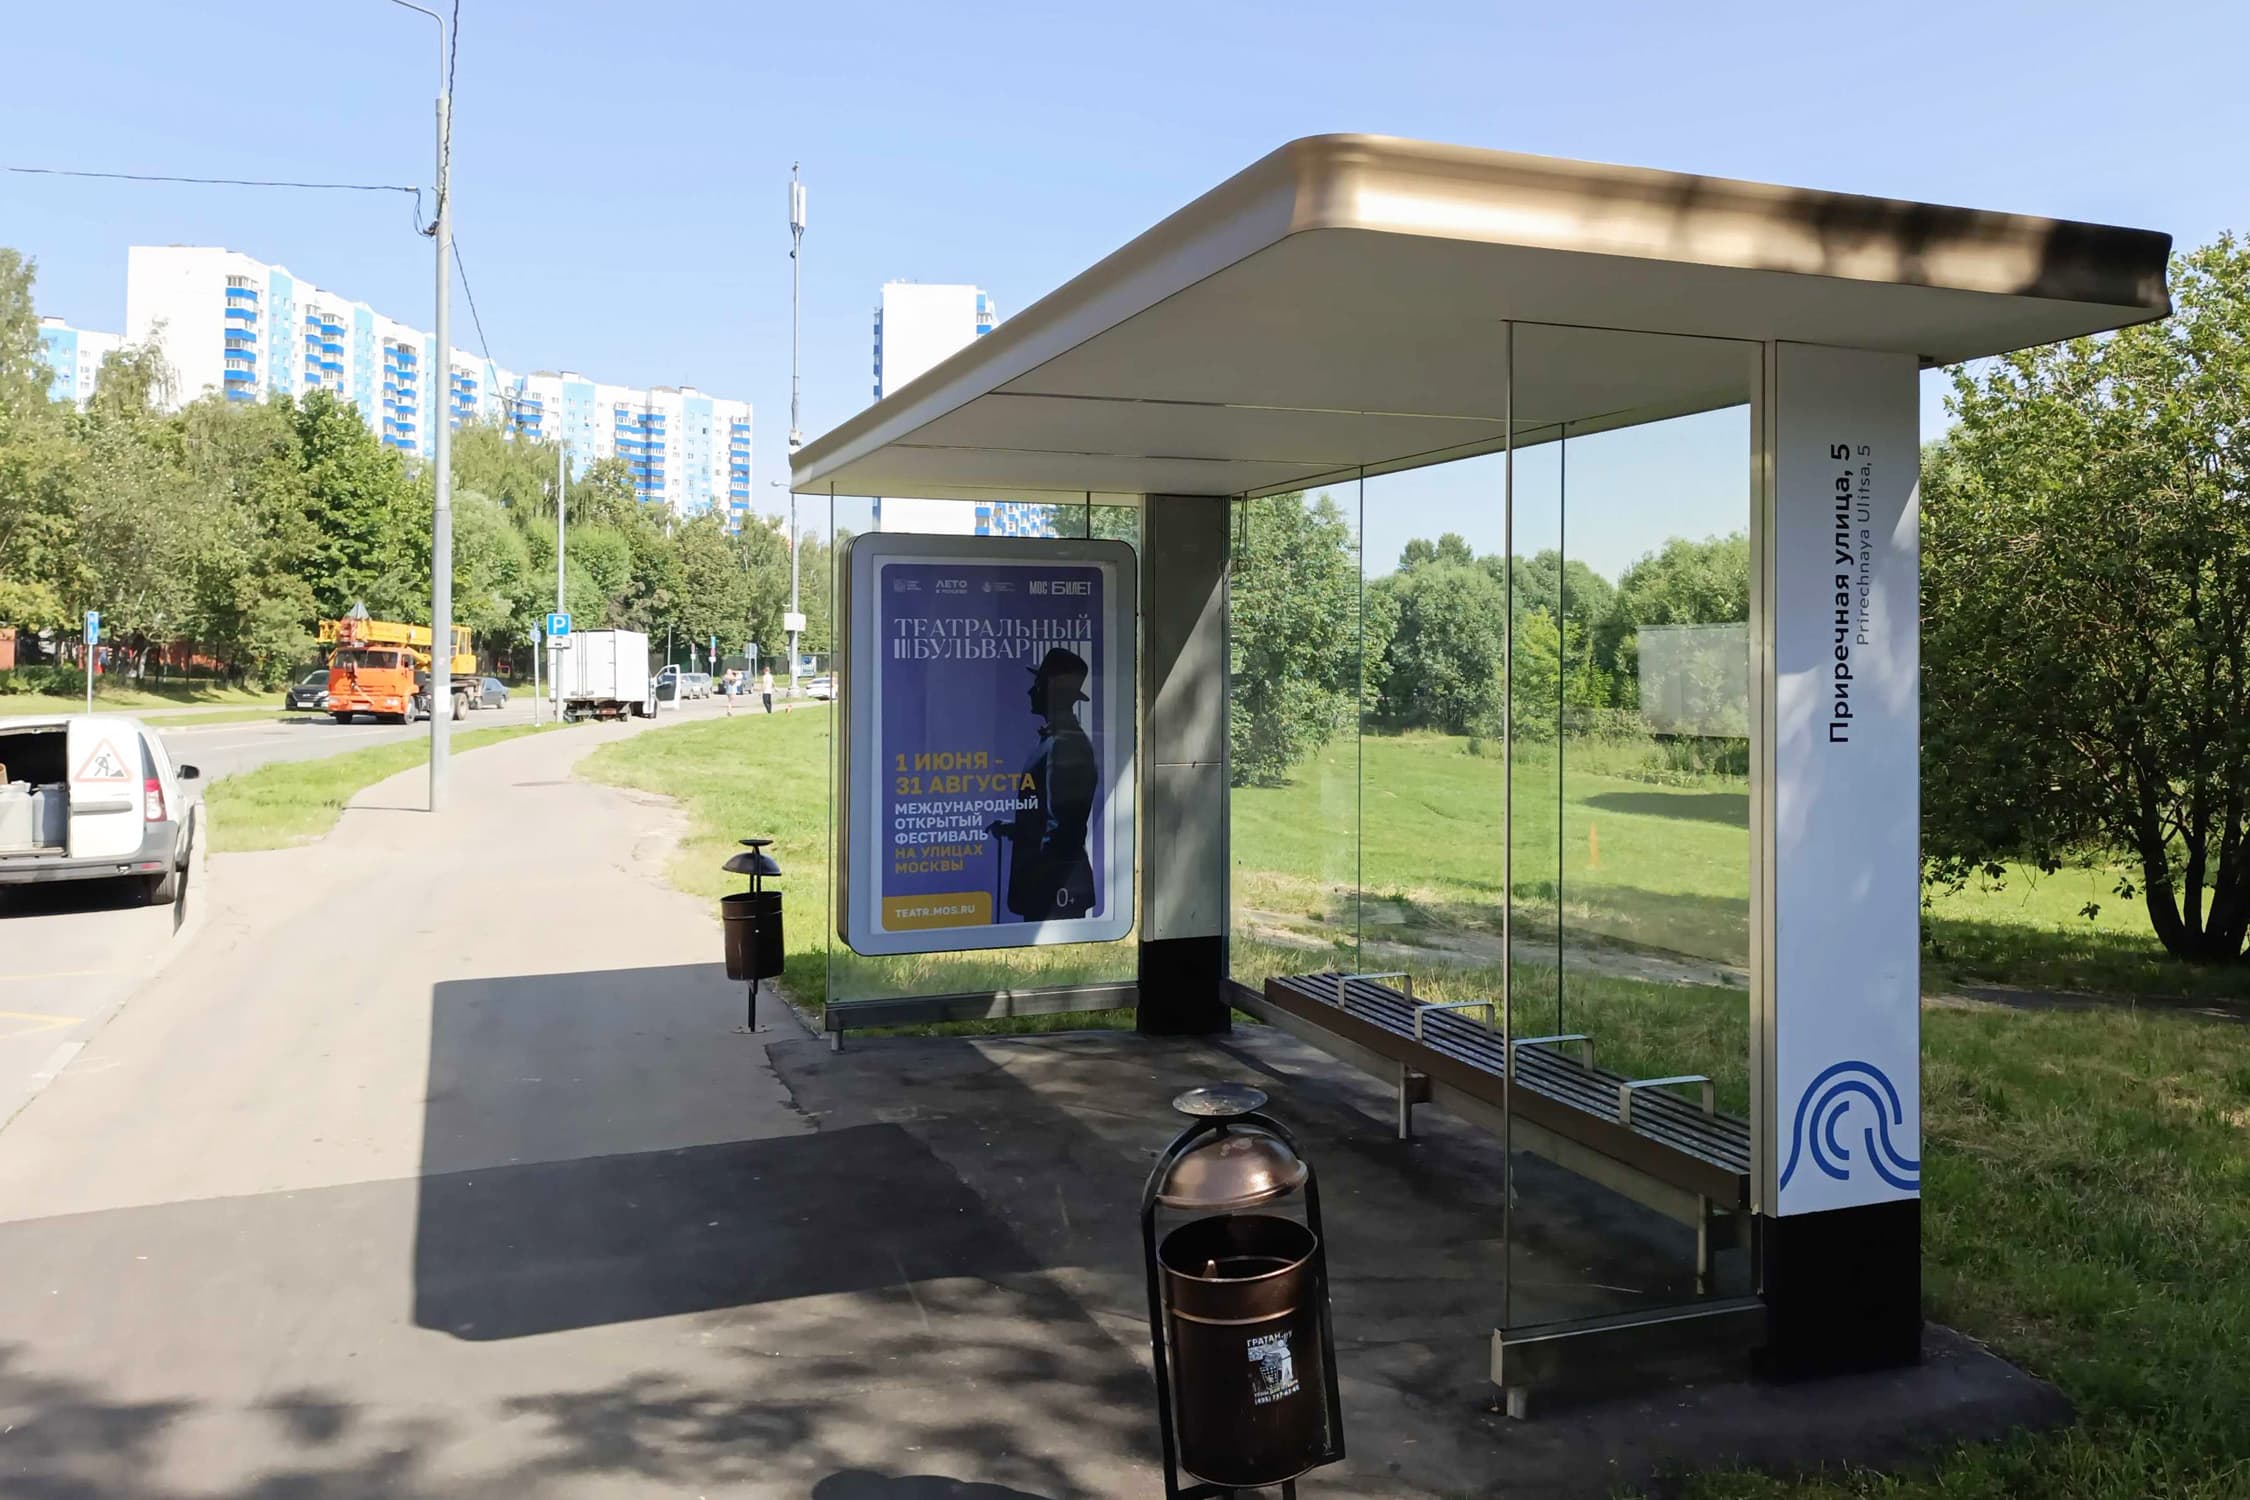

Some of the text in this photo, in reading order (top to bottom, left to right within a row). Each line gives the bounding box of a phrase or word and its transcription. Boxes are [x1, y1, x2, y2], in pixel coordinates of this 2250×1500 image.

[1856, 444, 1872, 646] Prirechnaya Ulitsa, 5
[1829, 443, 1854, 744] Приречная улица, 5
[553, 616, 566, 634] P
[894, 614, 1092, 639] ТЕАТРАЛЬНЫЙ
[913, 638, 1030, 659] БУЛЬВАР
[895, 754, 907, 772] 1
[914, 751, 988, 771] ИЮНЯ
[895, 772, 1036, 795] 31 АВГУСТА
[895, 795, 1039, 815] МЕЖДУНАРОДНЫЙ
[895, 812, 983, 830] ОТКРЫТЫЙ
[895, 830, 989, 845] ФЕСТИВАЛЬ
[895, 844, 983, 859] НА УЛИЦАХ
[895, 859, 964, 874] МОСКВЫ
[1056, 888, 1075, 908] 0+
[896, 904, 976, 919] TEATR.MOS.RU
